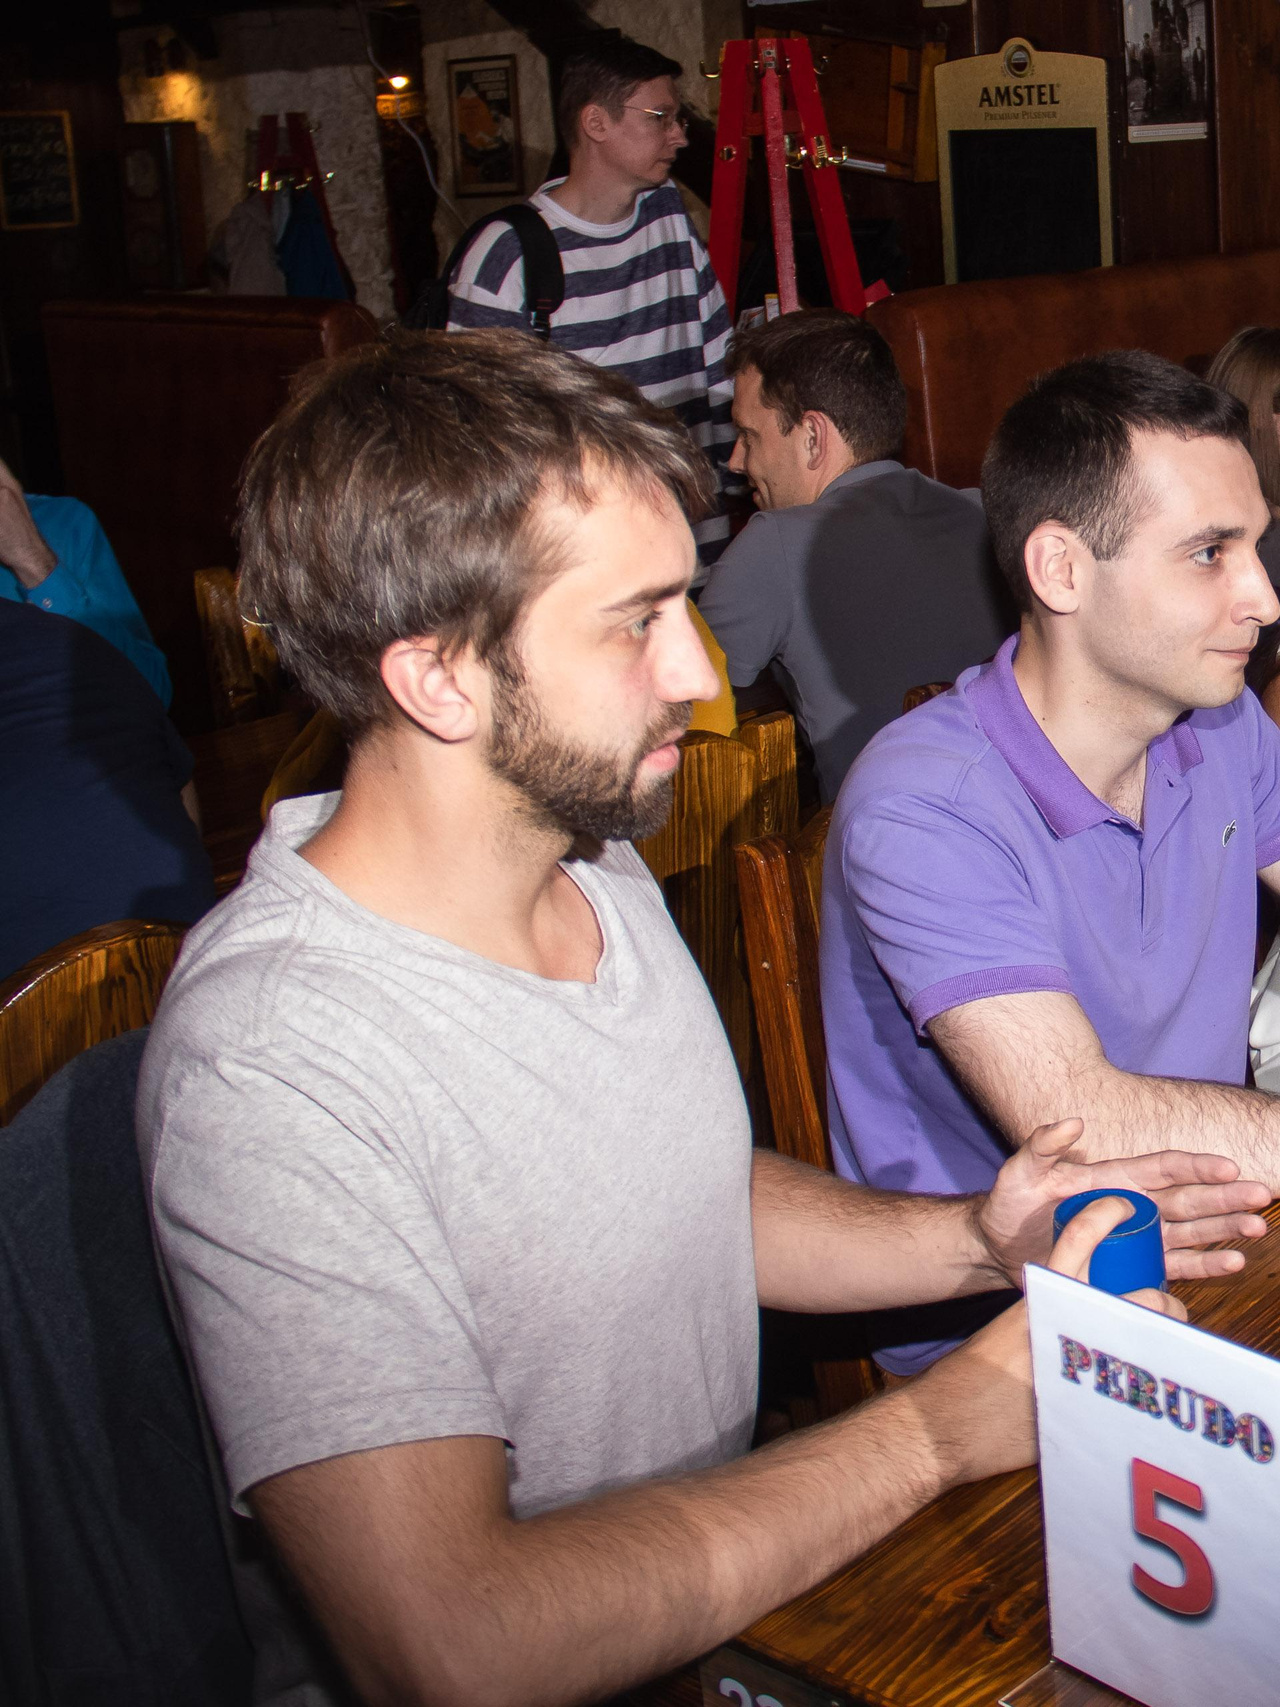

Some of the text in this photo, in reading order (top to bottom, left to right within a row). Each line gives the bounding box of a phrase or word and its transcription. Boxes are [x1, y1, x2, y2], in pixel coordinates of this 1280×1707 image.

[979, 84, 1060, 108] AMSTEL
[1057, 1333, 1276, 1464] PERUDO
[1130, 1456, 1215, 1616] 5
